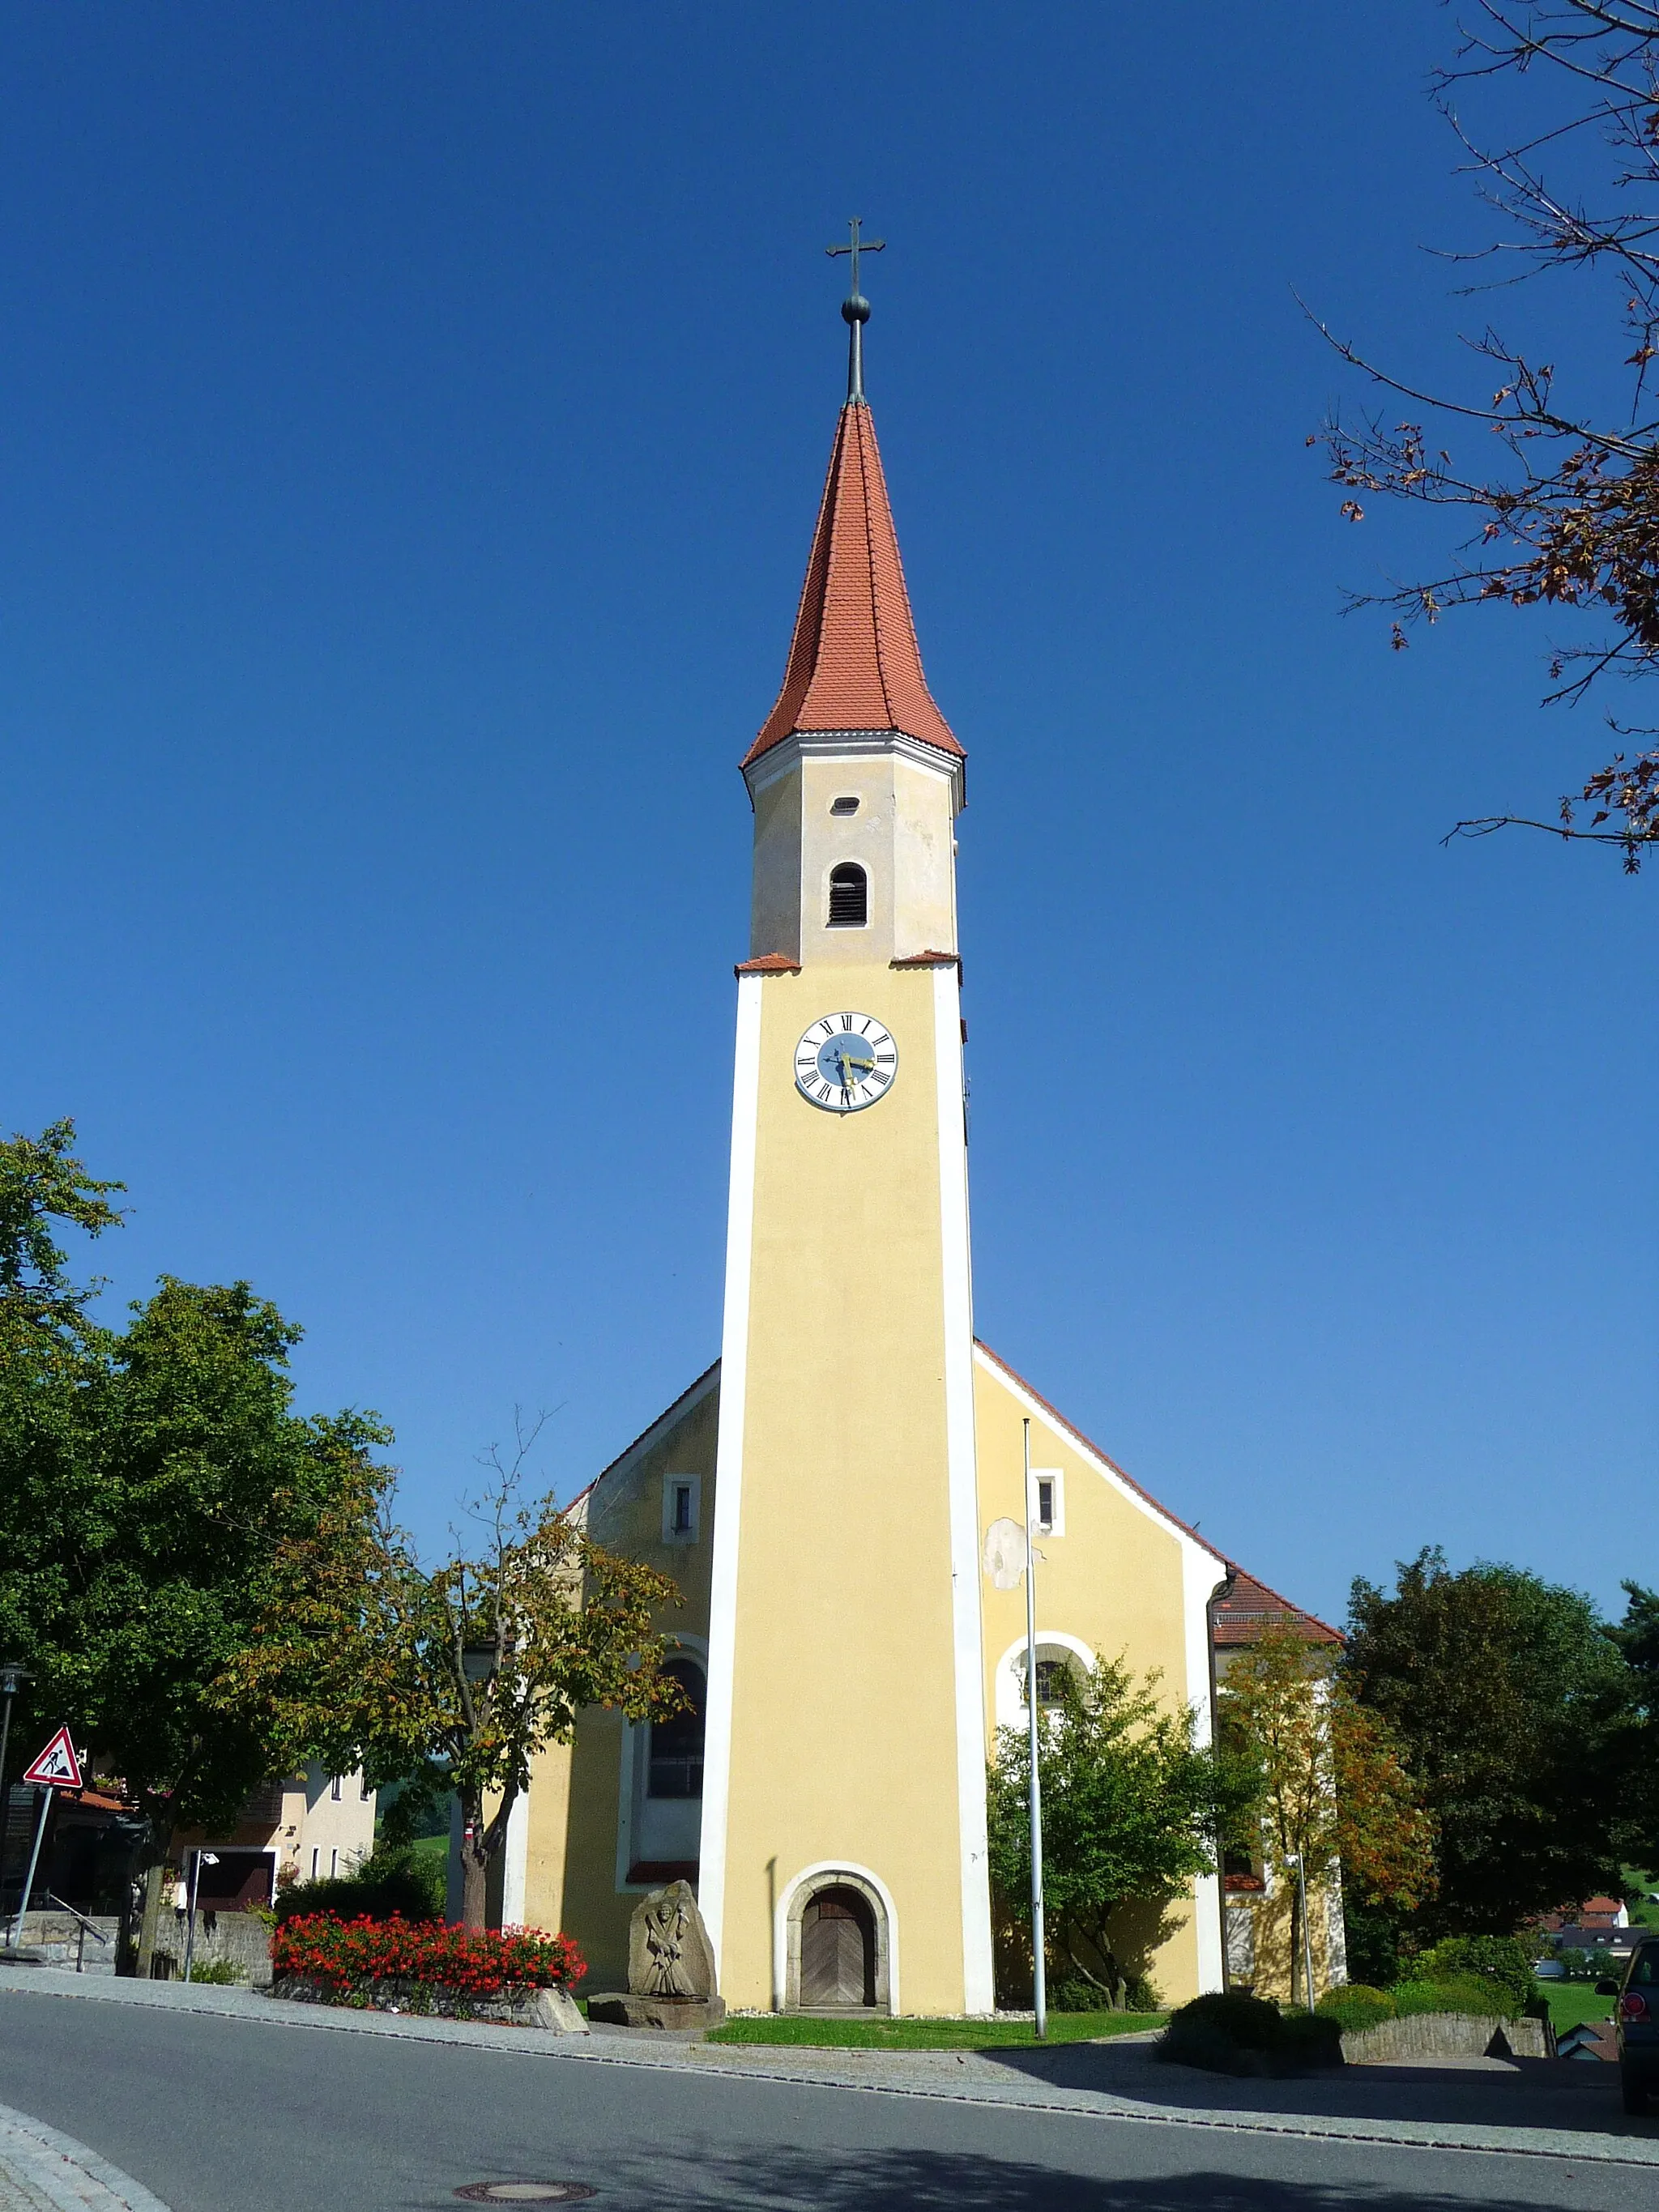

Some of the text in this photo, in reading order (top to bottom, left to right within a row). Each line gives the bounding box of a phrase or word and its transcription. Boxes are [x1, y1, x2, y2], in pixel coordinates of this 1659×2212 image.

[819, 1020, 834, 1038] XI
[841, 1015, 852, 1031] XII
[861, 1020, 872, 1034] I
[803, 1036, 821, 1049] X
[872, 1034, 889, 1046] II
[798, 1056, 816, 1065] IX
[876, 1054, 895, 1063] III
[800, 1069, 820, 1089] VIII
[817, 1083, 833, 1102] VII
[861, 1085, 873, 1100] V
